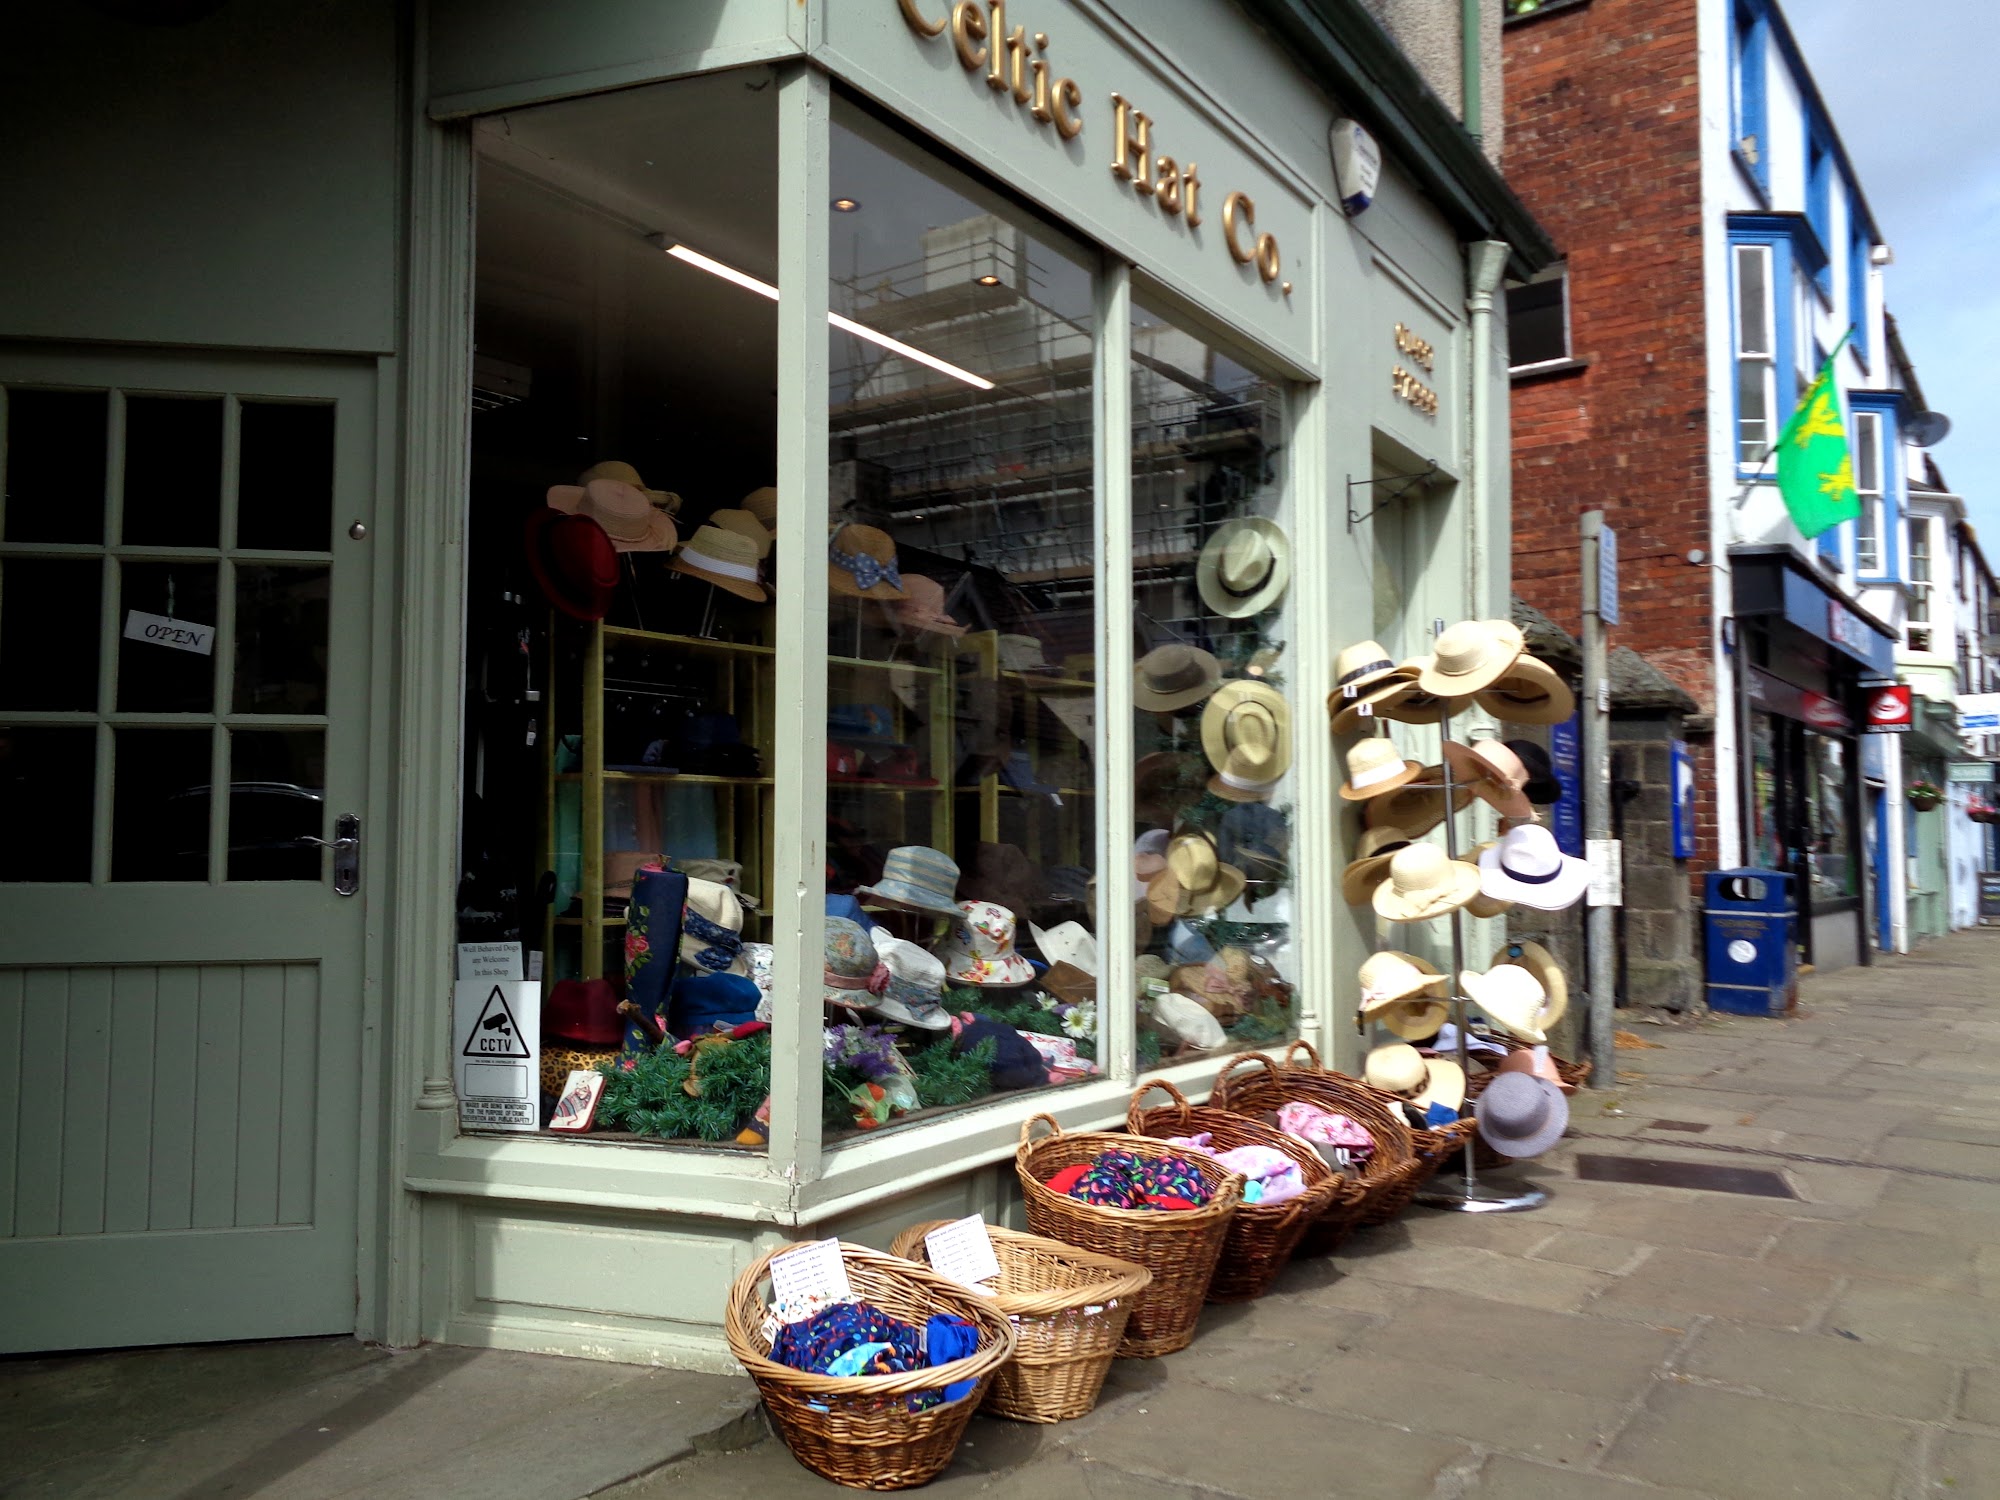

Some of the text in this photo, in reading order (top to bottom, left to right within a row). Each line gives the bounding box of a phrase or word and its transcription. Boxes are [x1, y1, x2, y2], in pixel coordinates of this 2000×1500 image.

[1111, 92, 1202, 228] Hat
[1223, 191, 1293, 296] Co.
[145, 624, 205, 646] OPEN
[477, 944, 502, 953] Behaved
[504, 944, 519, 953] Dogs
[493, 968, 509, 976] Shop
[480, 1039, 511, 1051] CCTV
